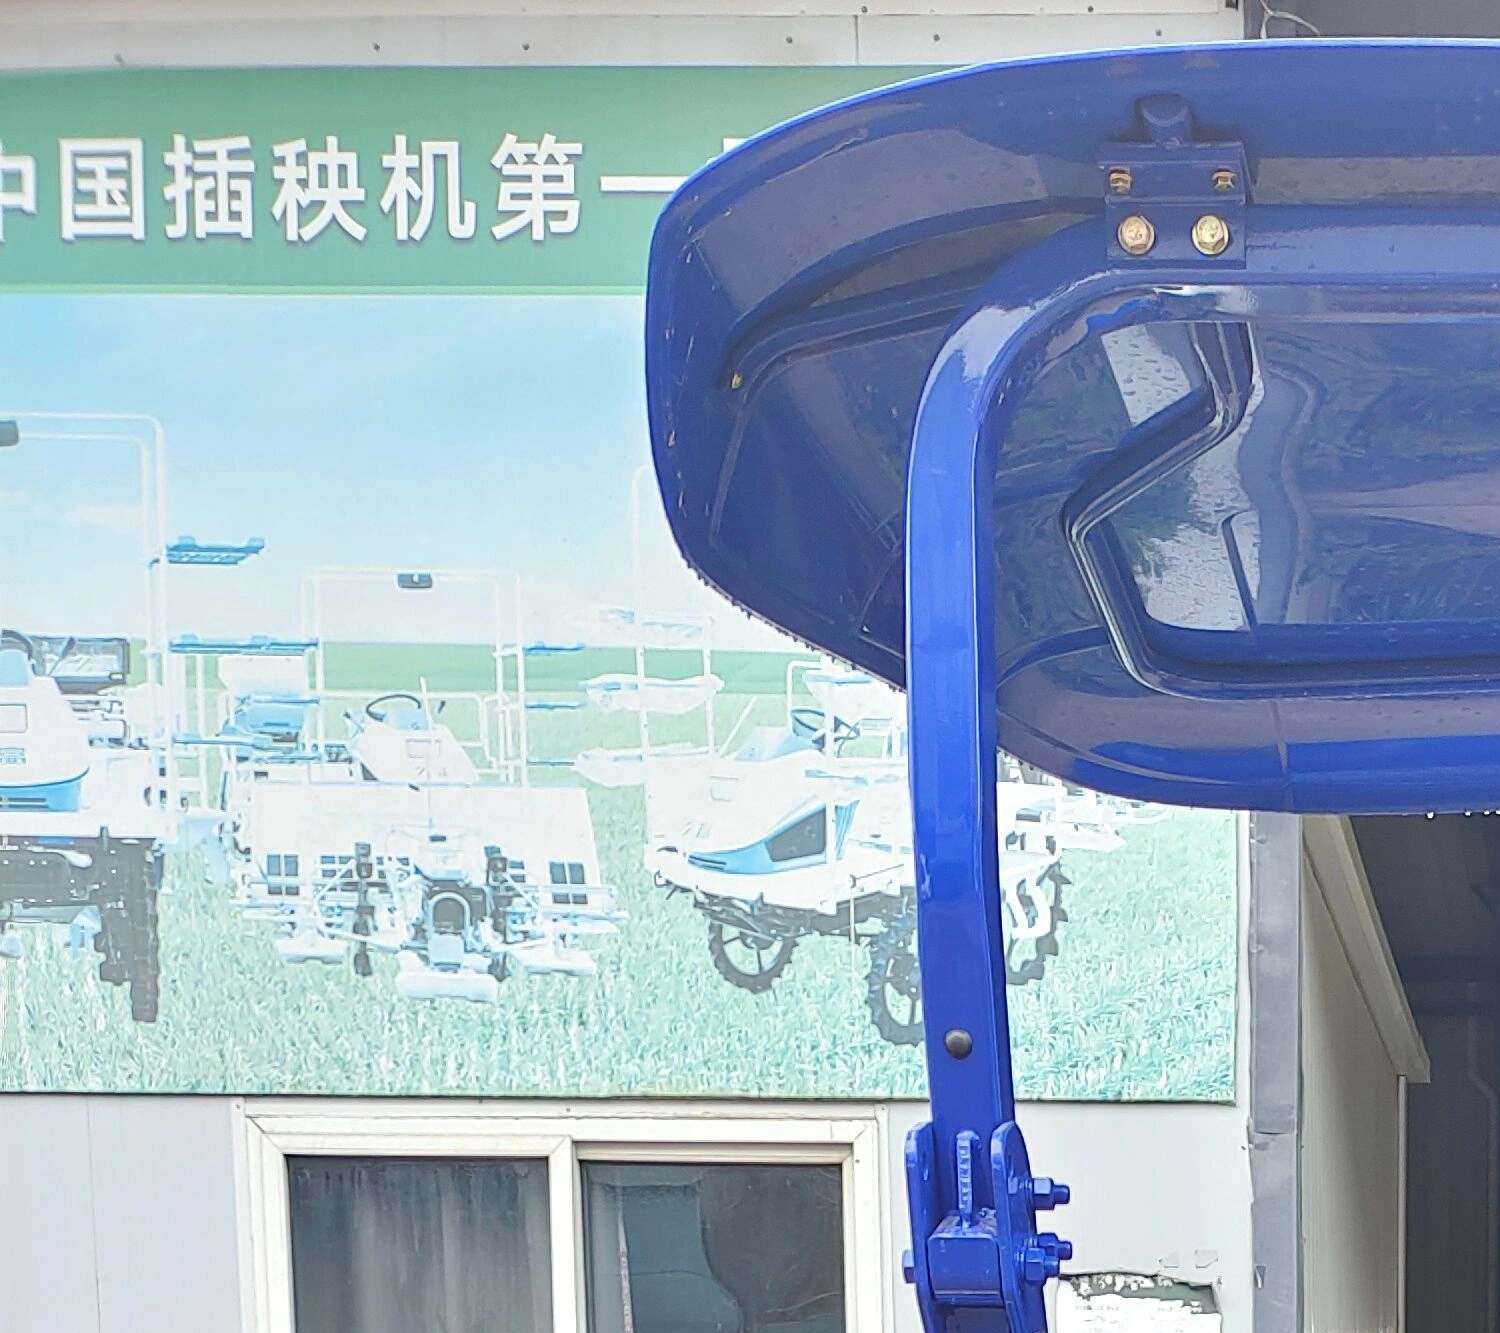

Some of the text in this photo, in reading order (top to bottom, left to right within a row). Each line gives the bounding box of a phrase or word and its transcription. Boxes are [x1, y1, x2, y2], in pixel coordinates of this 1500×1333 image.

[0, 133, 749, 243] 中国插秧机第一
